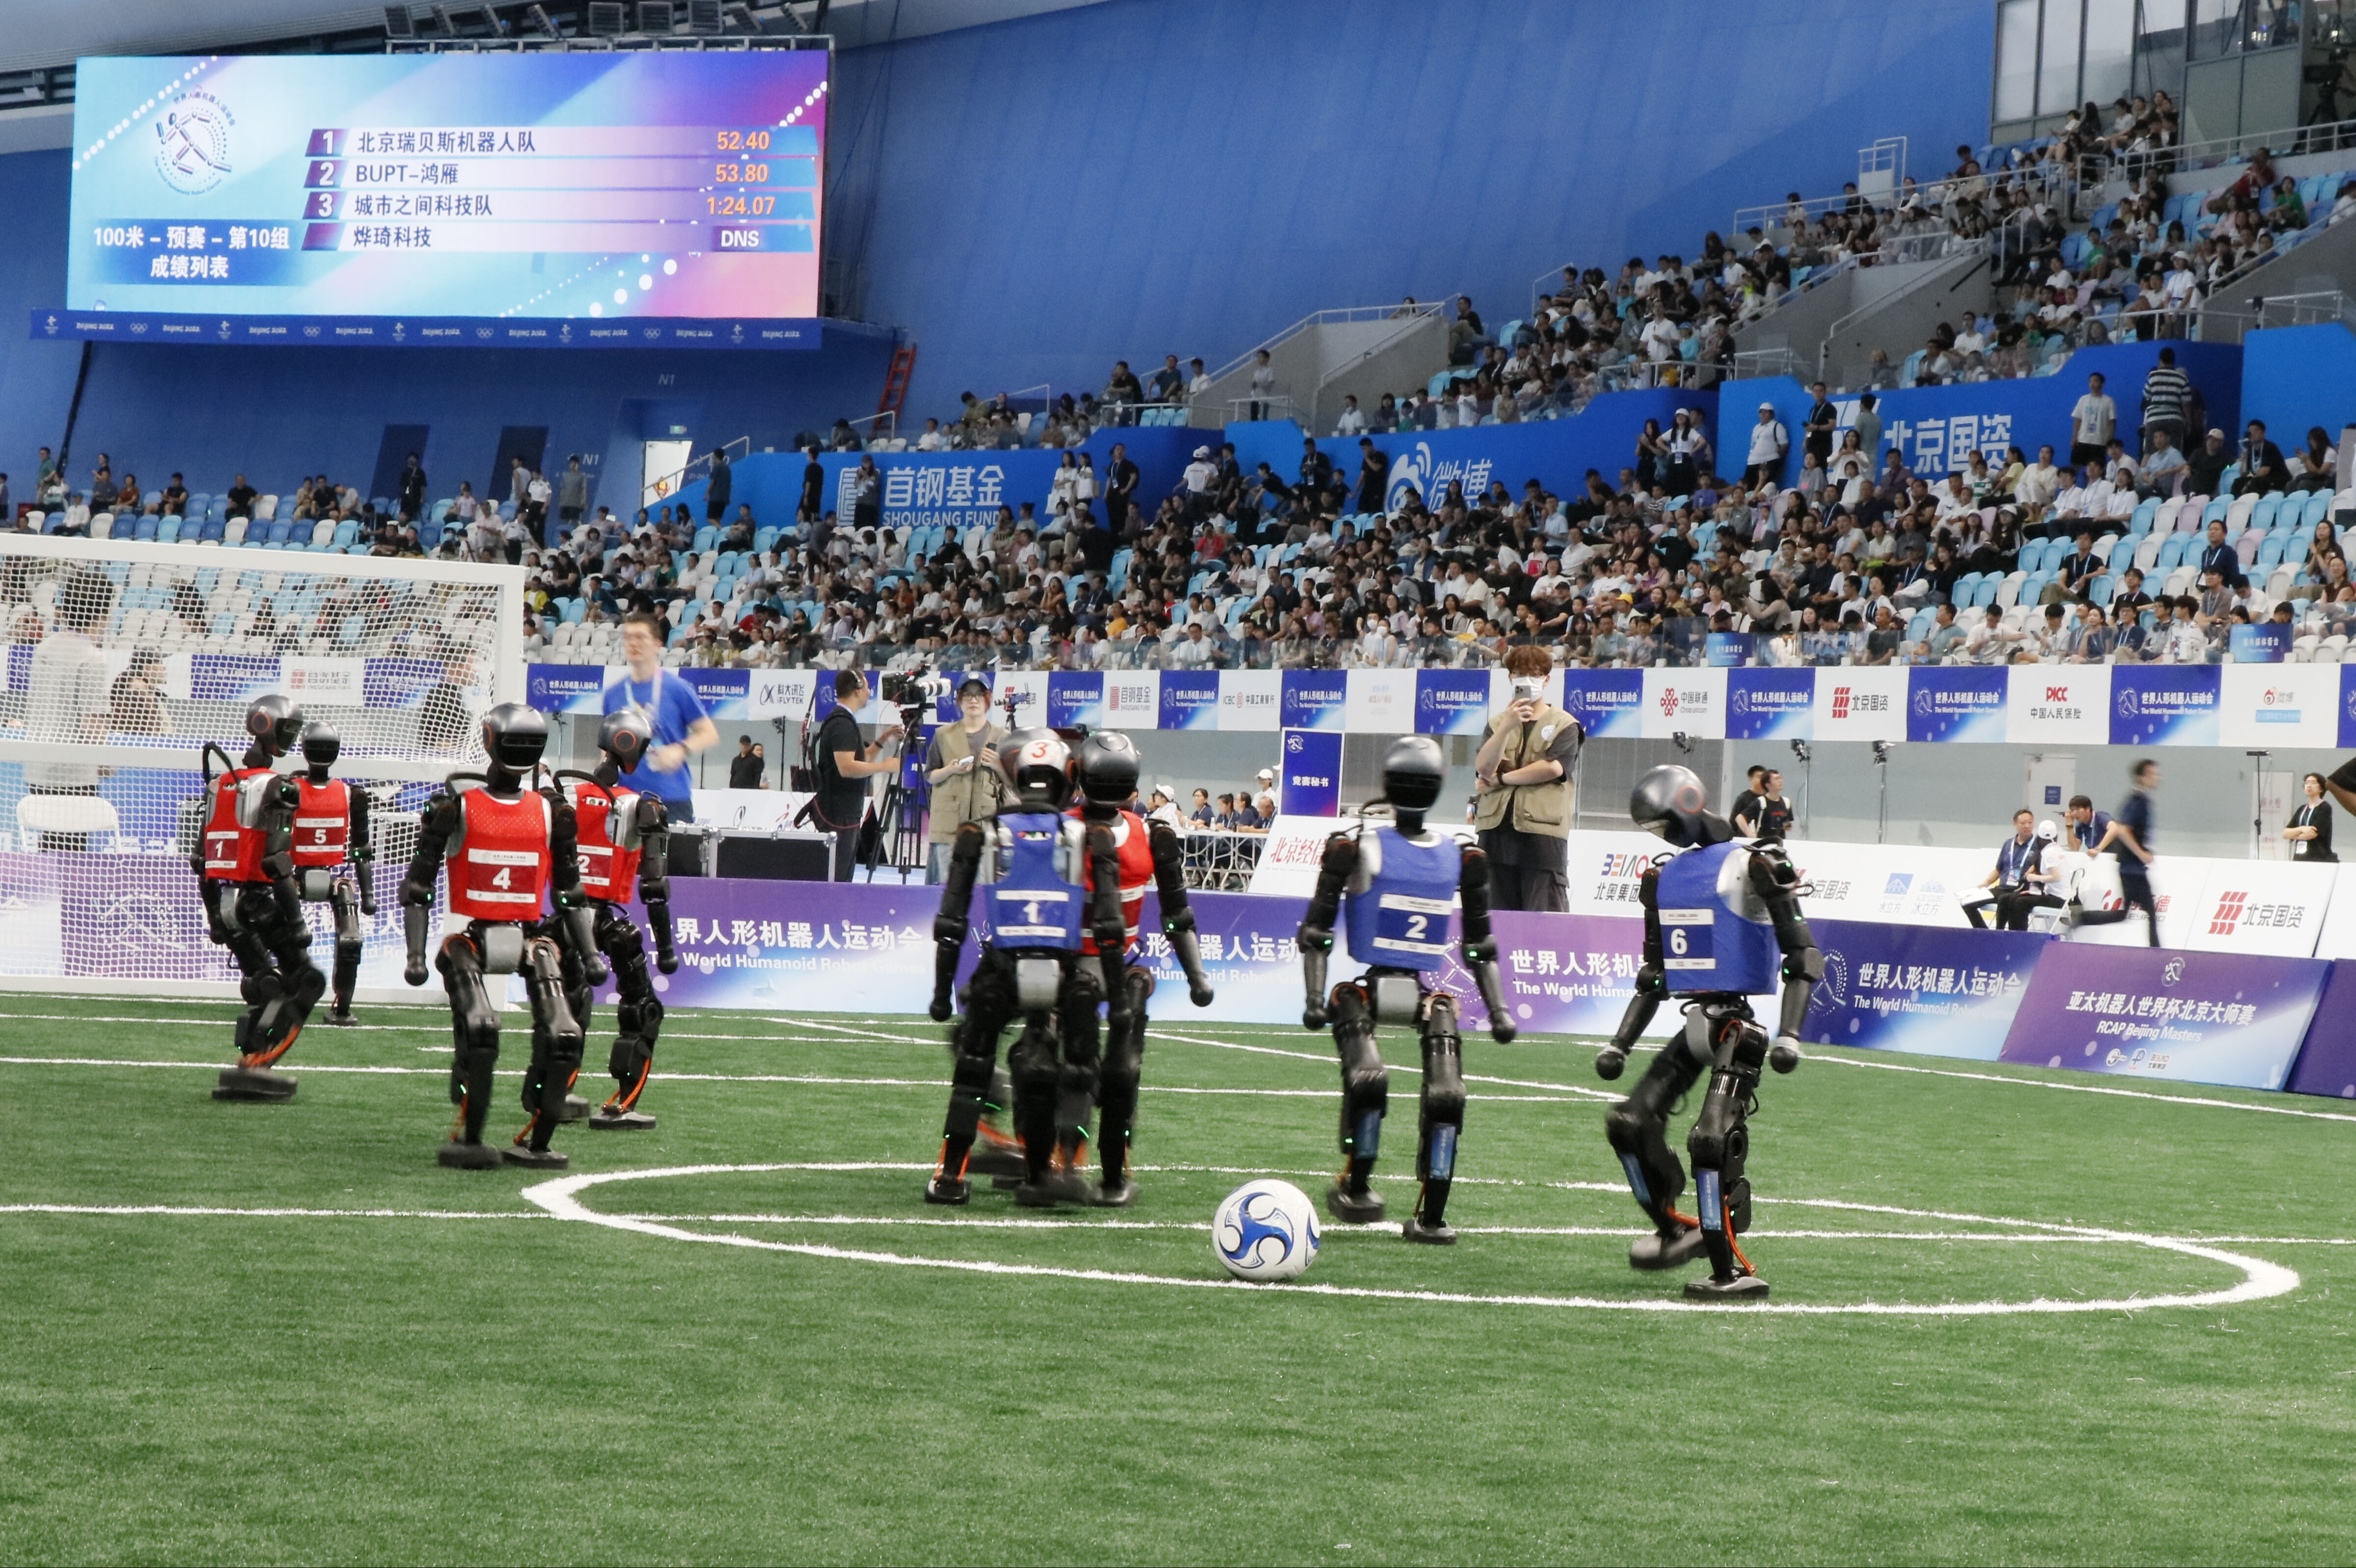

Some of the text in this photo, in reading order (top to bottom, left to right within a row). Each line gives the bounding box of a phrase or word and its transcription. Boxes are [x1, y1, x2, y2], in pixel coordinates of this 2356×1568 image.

[322, 131, 334, 155] 1
[358, 131, 536, 153] 北京瑞贝斯机器人队
[717, 131, 770, 150] 52.40
[319, 162, 335, 186] 2
[715, 164, 768, 182] 53.80
[318, 193, 333, 218] 3
[355, 194, 493, 217] 城市之间科技队
[707, 196, 776, 215] 1:24.07
[93, 226, 144, 248] 100米
[167, 226, 206, 249] 预赛
[229, 226, 290, 249] 第10组
[353, 226, 432, 248] 烨琦科技
[721, 230, 759, 247] DNS
[150, 255, 229, 278] 成绩列表
[658, 374, 675, 385] N1
[1883, 415, 2012, 473] 北京国资
[583, 454, 599, 466] N1
[885, 465, 1005, 507] 首钢基金
[1428, 458, 1492, 511] 微博
[883, 511, 961, 526] SHOUGANG
[777, 684, 805, 696] 科大讯飞
[1121, 686, 1151, 703] 首钢基金
[1246, 694, 1275, 705] 中国工商银行
[1586, 691, 1638, 702] 世界人形机器人运动会
[1681, 691, 1708, 704] 中国联通
[1752, 691, 1808, 703] 世界人形机器人运动会
[1935, 691, 1999, 704] 世界人形机器人运动会
[2046, 687, 2068, 702] PICC
[2141, 692, 2214, 704] 世界人形机器人运动会
[2276, 691, 2295, 704] 微博
[1223, 695, 1235, 705] ICBC
[1852, 694, 1888, 711] 北京国资
[2030, 708, 2082, 719] 中国人民保险
[1032, 742, 1048, 758] 3
[1292, 775, 1329, 788] 竞赛秘书
[314, 829, 327, 844] 5
[215, 840, 223, 858] 1
[576, 854, 590, 874] 2
[493, 867, 511, 890] 4
[1594, 882, 1642, 902] 北奥集团
[1023, 901, 1038, 924] 1
[2242, 904, 2305, 928] 北京国资
[645, 917, 923, 951] 界人形机器人运动会
[1405, 915, 1428, 939] 2
[1671, 928, 1687, 955] 6
[683, 952, 732, 968] World
[736, 954, 817, 970] Humanoid
[821, 957, 867, 972] Robot
[1509, 949, 1644, 978] 世界人形机
[1513, 981, 1540, 995] The
[1543, 982, 1588, 996] World
[1858, 962, 2022, 997] 世界人形机器人运动会
[1854, 994, 1870, 1009] The
[1873, 996, 1901, 1012] World
[1901, 998, 1950, 1015] Humanoid
[2065, 990, 2257, 1026] 亚太机器人世界杯北京大师赛
[2096, 1020, 2202, 1042] RCAP Beijing Masters
